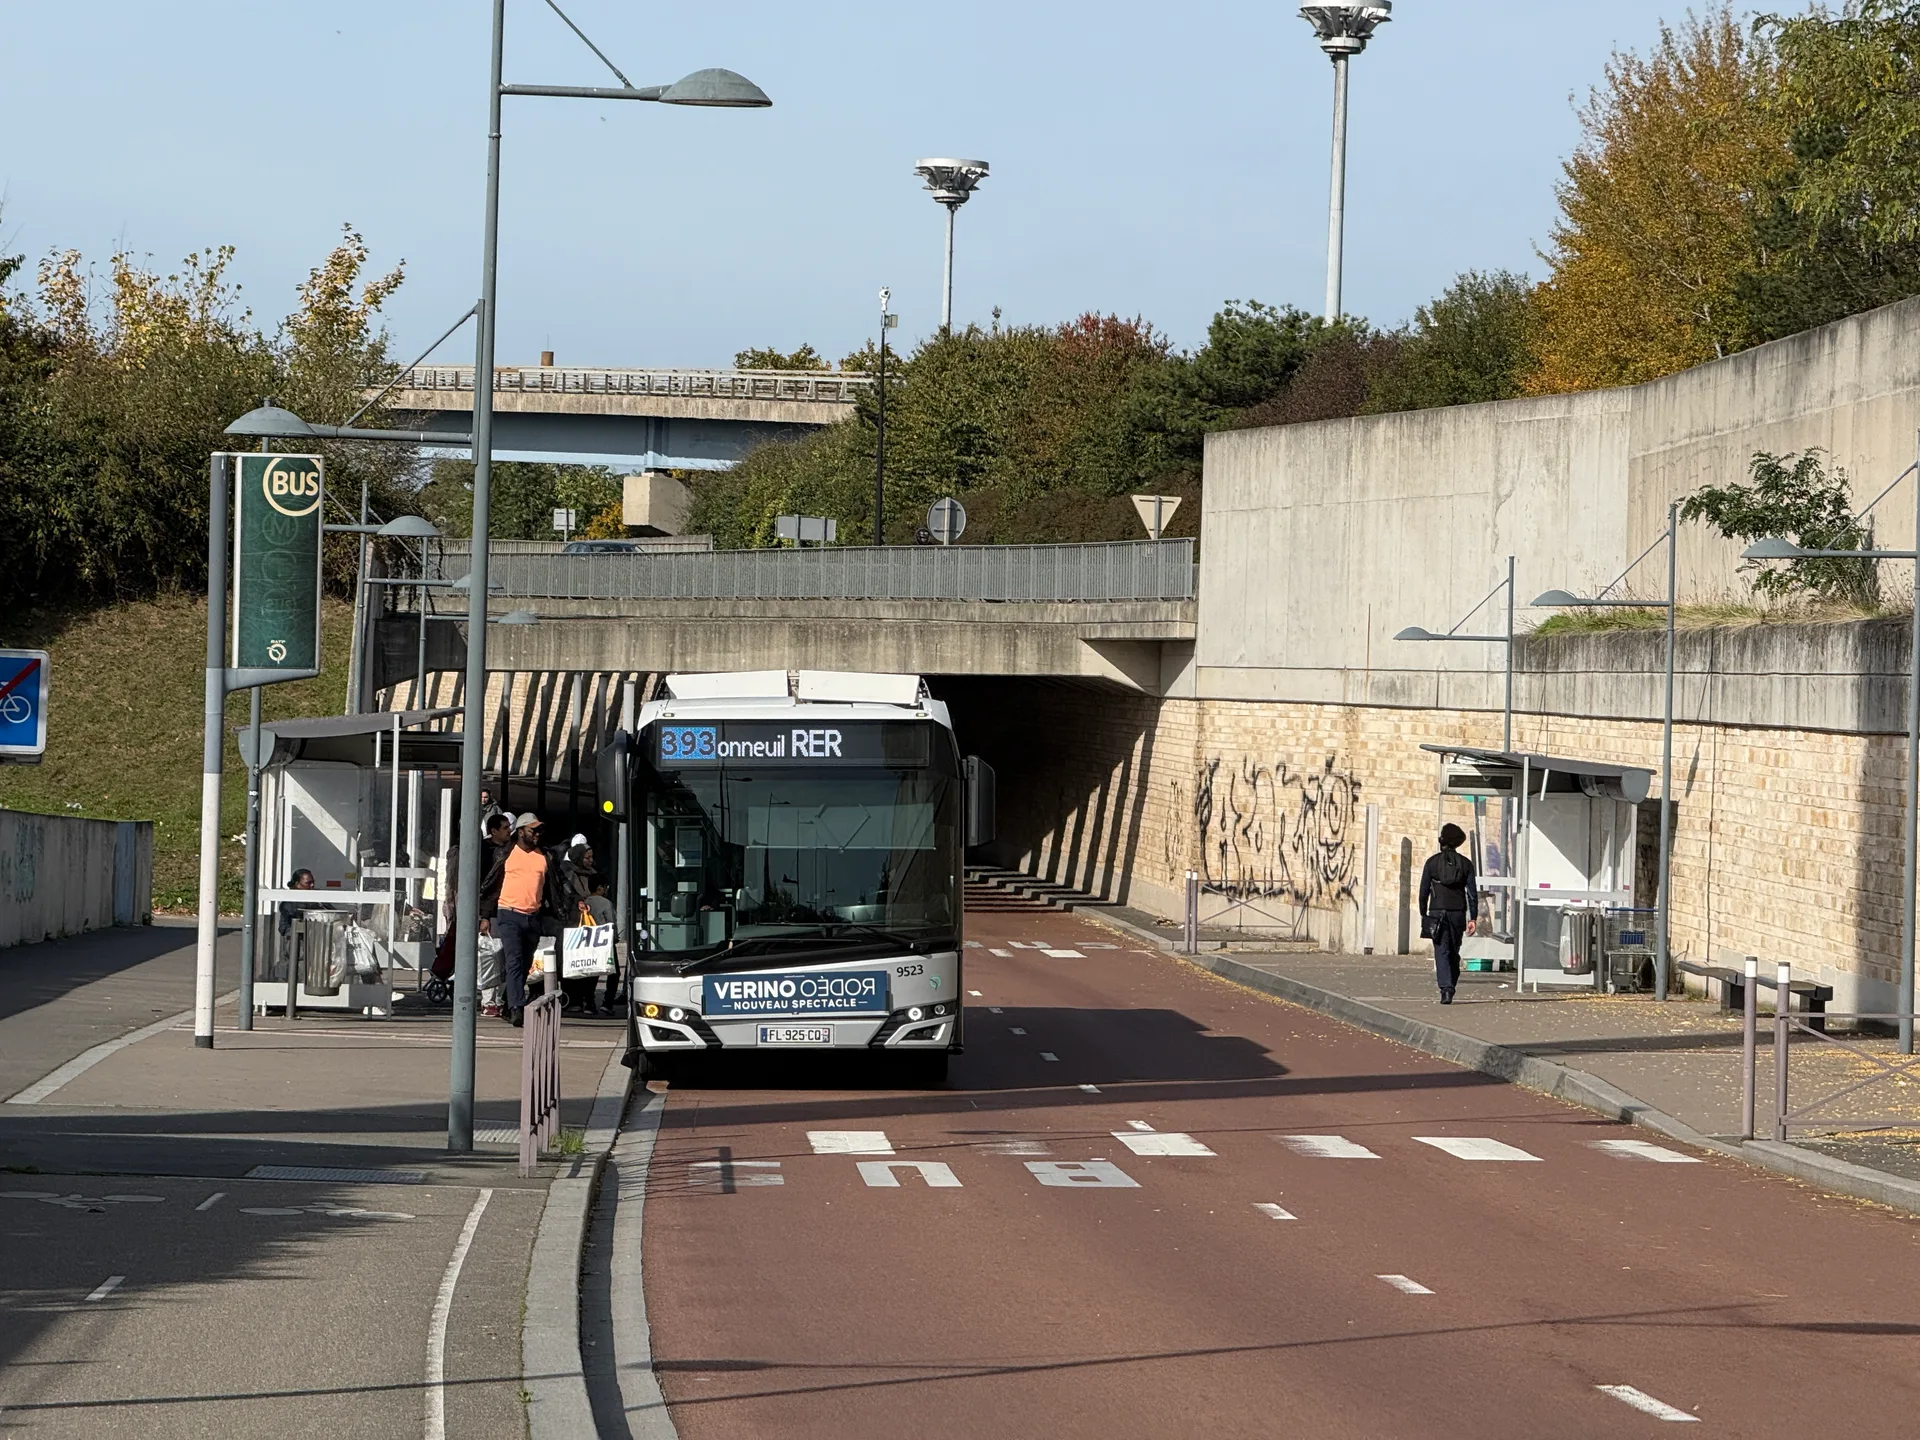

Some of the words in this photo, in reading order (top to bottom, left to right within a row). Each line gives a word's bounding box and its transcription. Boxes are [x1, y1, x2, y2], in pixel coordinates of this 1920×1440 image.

[272, 471, 319, 496] BUS
[662, 730, 716, 756] 393
[791, 729, 842, 757] RER
[571, 959, 597, 968] ACTION
[896, 964, 924, 978] 9523
[714, 980, 796, 999] VERINO
[734, 1000, 788, 1011] NOUVEAU
[792, 998, 857, 1009] SPECTACLE
